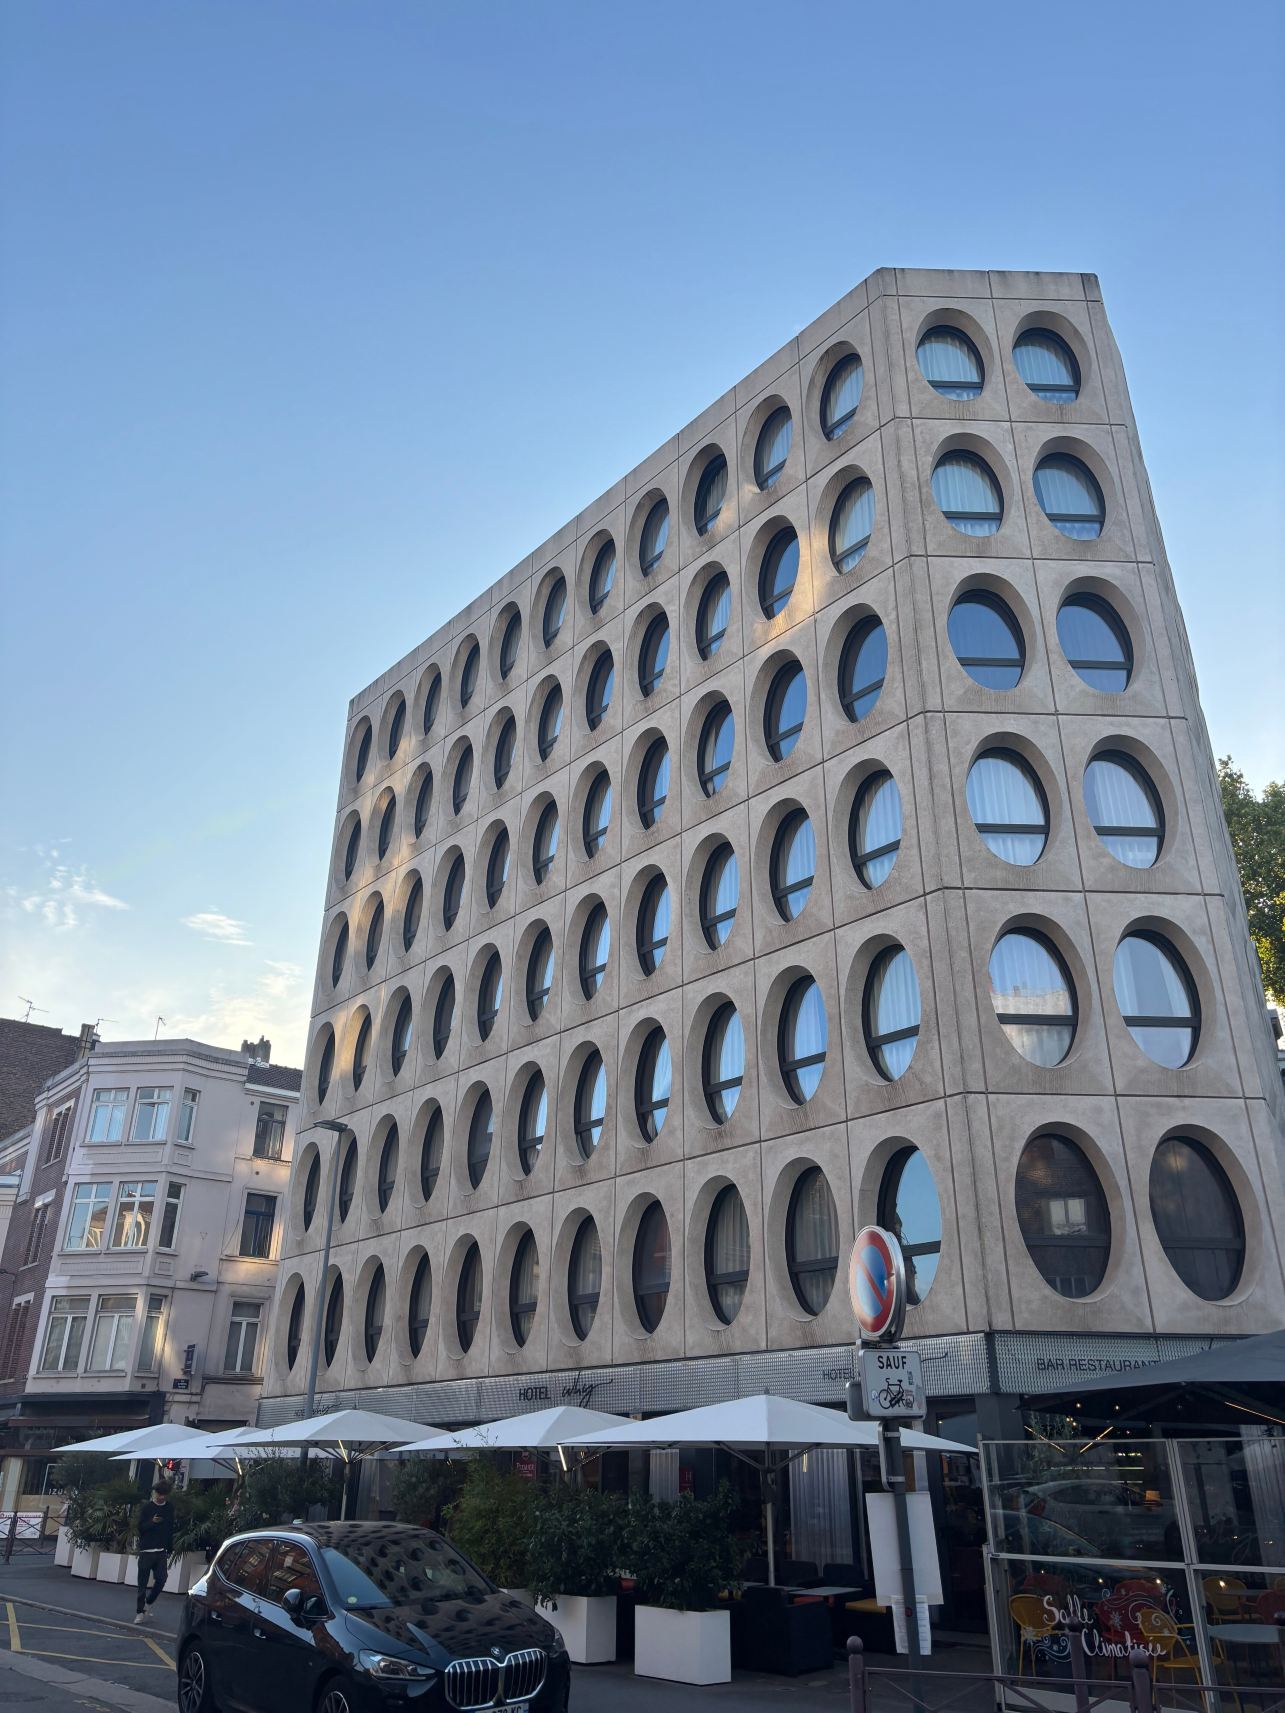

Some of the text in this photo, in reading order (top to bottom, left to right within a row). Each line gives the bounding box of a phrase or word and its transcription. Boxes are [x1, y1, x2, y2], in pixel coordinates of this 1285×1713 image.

[877, 1355, 907, 1370] SAUF
[1037, 1358, 1065, 1371] BAR
[822, 1368, 855, 1380] HOTEL
[518, 1386, 551, 1401] HOTEL
[1042, 1593, 1094, 1625] Salle
[1081, 1627, 1167, 1657] Climatisée
